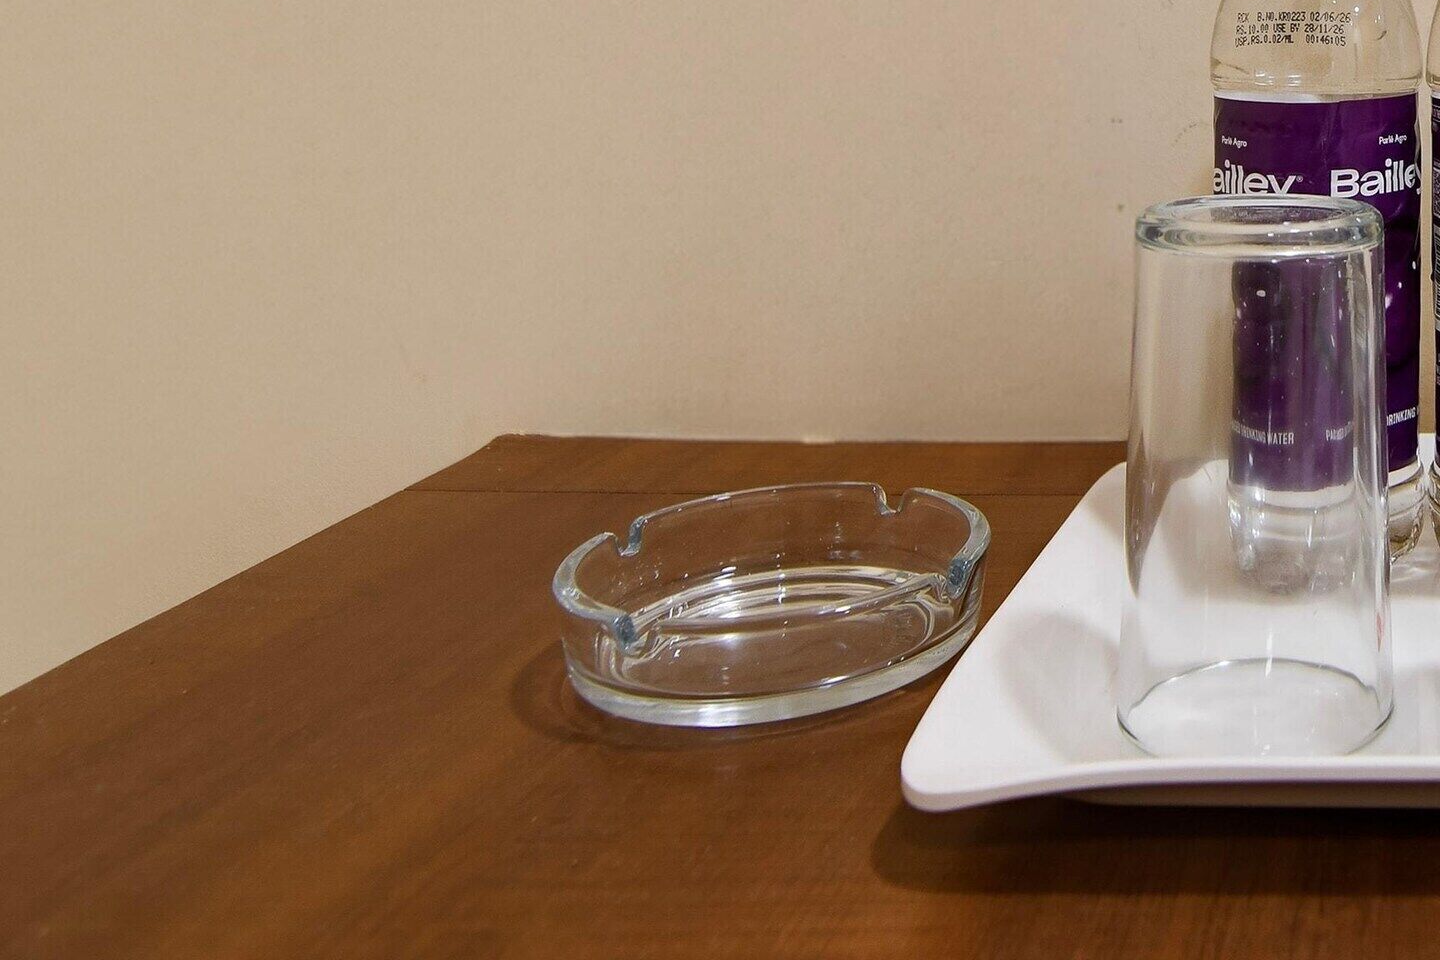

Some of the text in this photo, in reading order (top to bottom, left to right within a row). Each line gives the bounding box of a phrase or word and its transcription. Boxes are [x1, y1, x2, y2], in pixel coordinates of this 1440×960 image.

[1273, 23, 1286, 33] USE
[1290, 23, 1300, 33] BY
[1233, 137, 1247, 148] Agro
[1394, 134, 1407, 144] Agro
[1267, 432, 1294, 445] WATER
